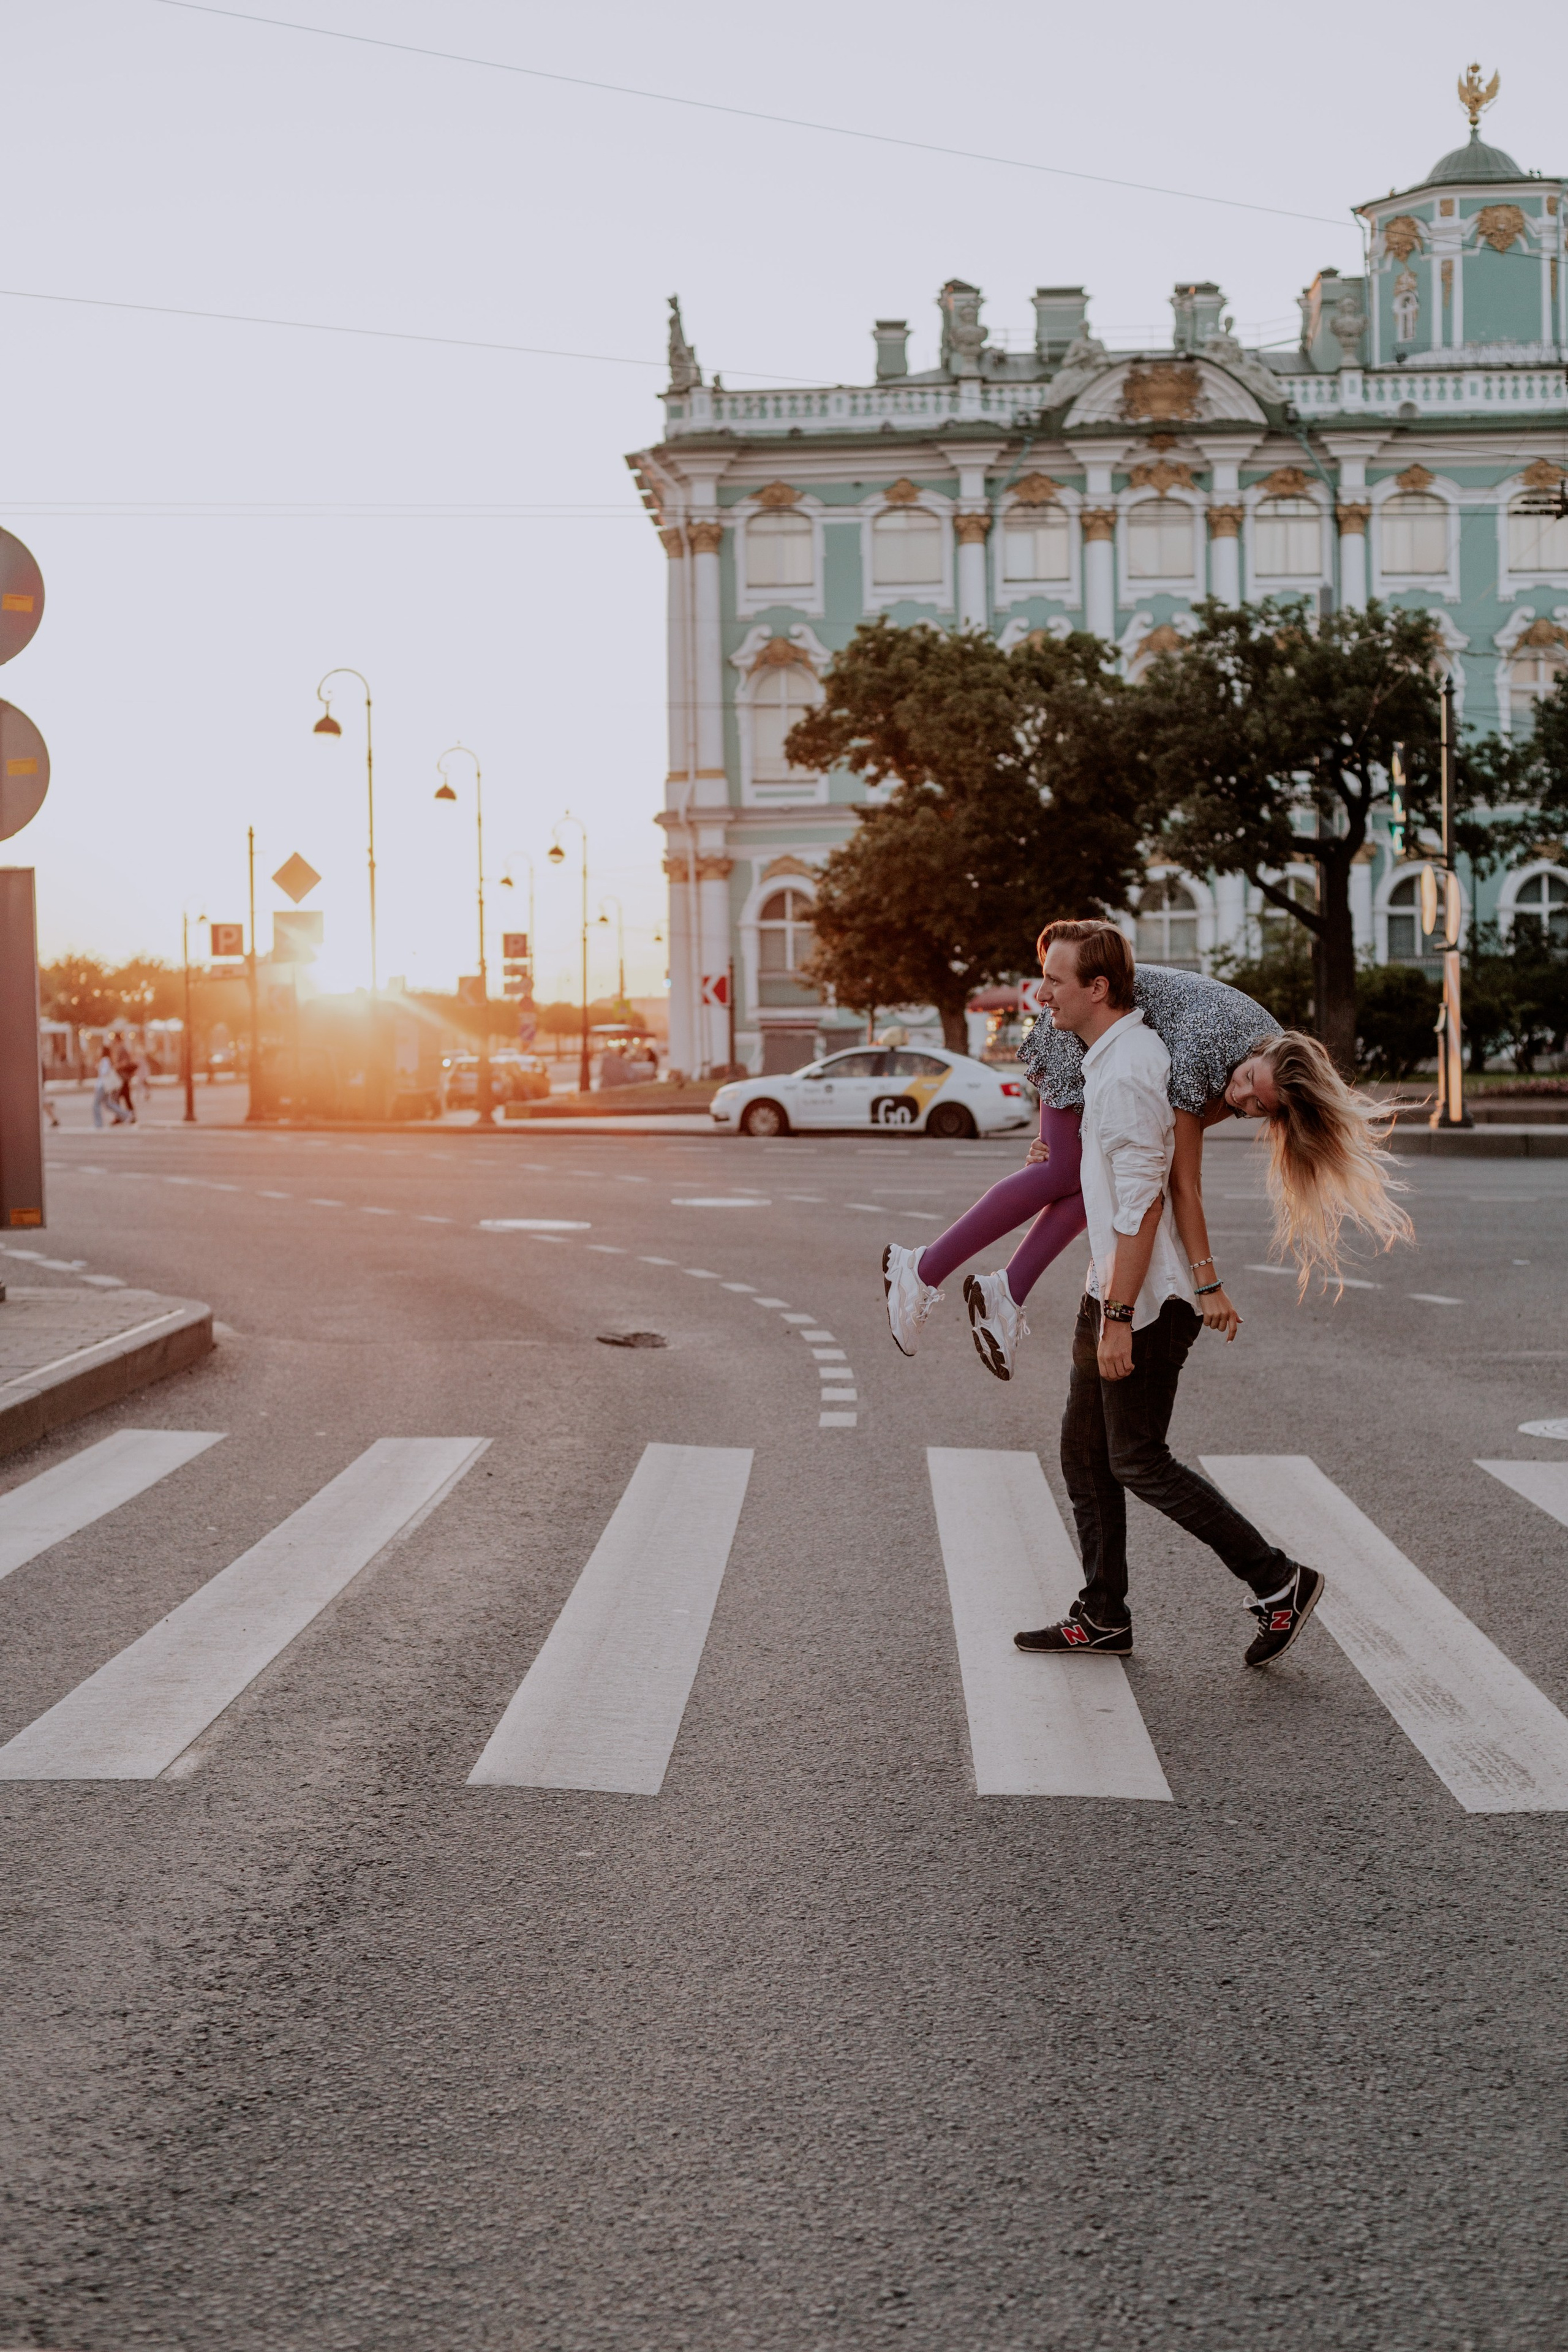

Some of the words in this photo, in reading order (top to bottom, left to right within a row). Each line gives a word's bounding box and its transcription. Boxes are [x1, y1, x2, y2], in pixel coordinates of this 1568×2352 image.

[219, 927, 238, 953] P
[509, 936, 524, 954] P
[878, 1099, 911, 1125] Go
[1270, 1610, 1293, 1630] N
[1060, 1624, 1090, 1645] N
